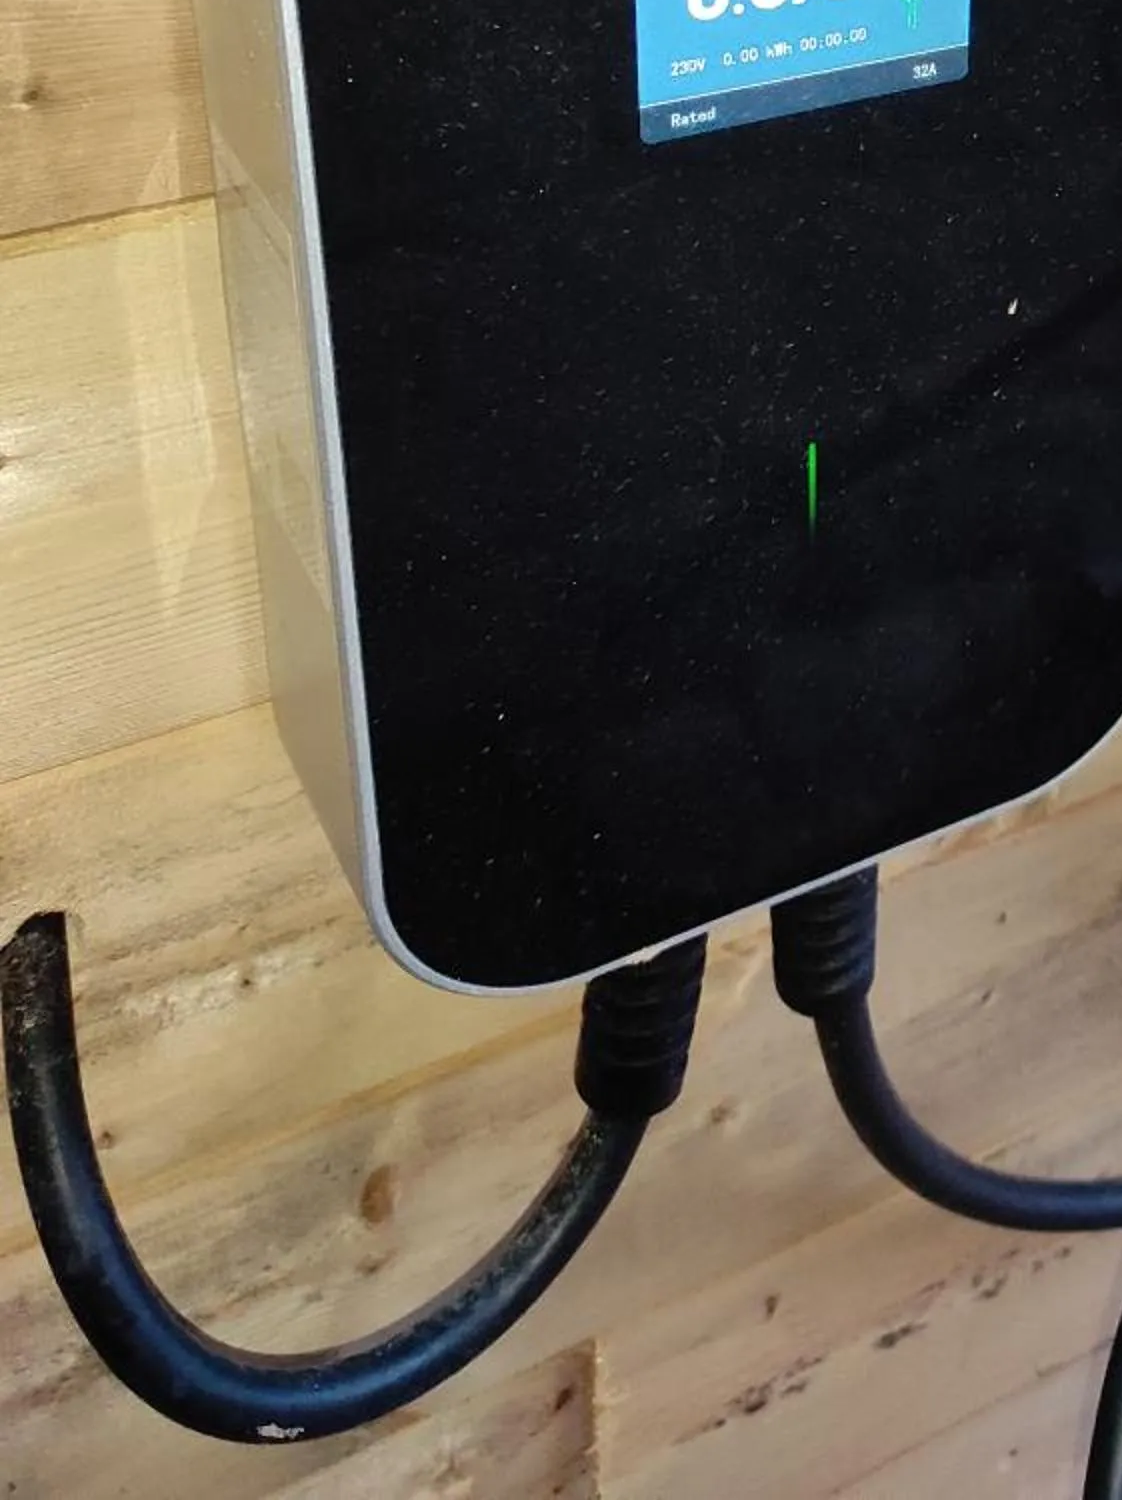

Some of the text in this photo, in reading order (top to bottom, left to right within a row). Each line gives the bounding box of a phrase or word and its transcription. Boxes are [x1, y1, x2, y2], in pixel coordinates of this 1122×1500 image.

[671, 57, 707, 77] 230V
[912, 61, 937, 80] 32A
[671, 106, 716, 129] Rated
